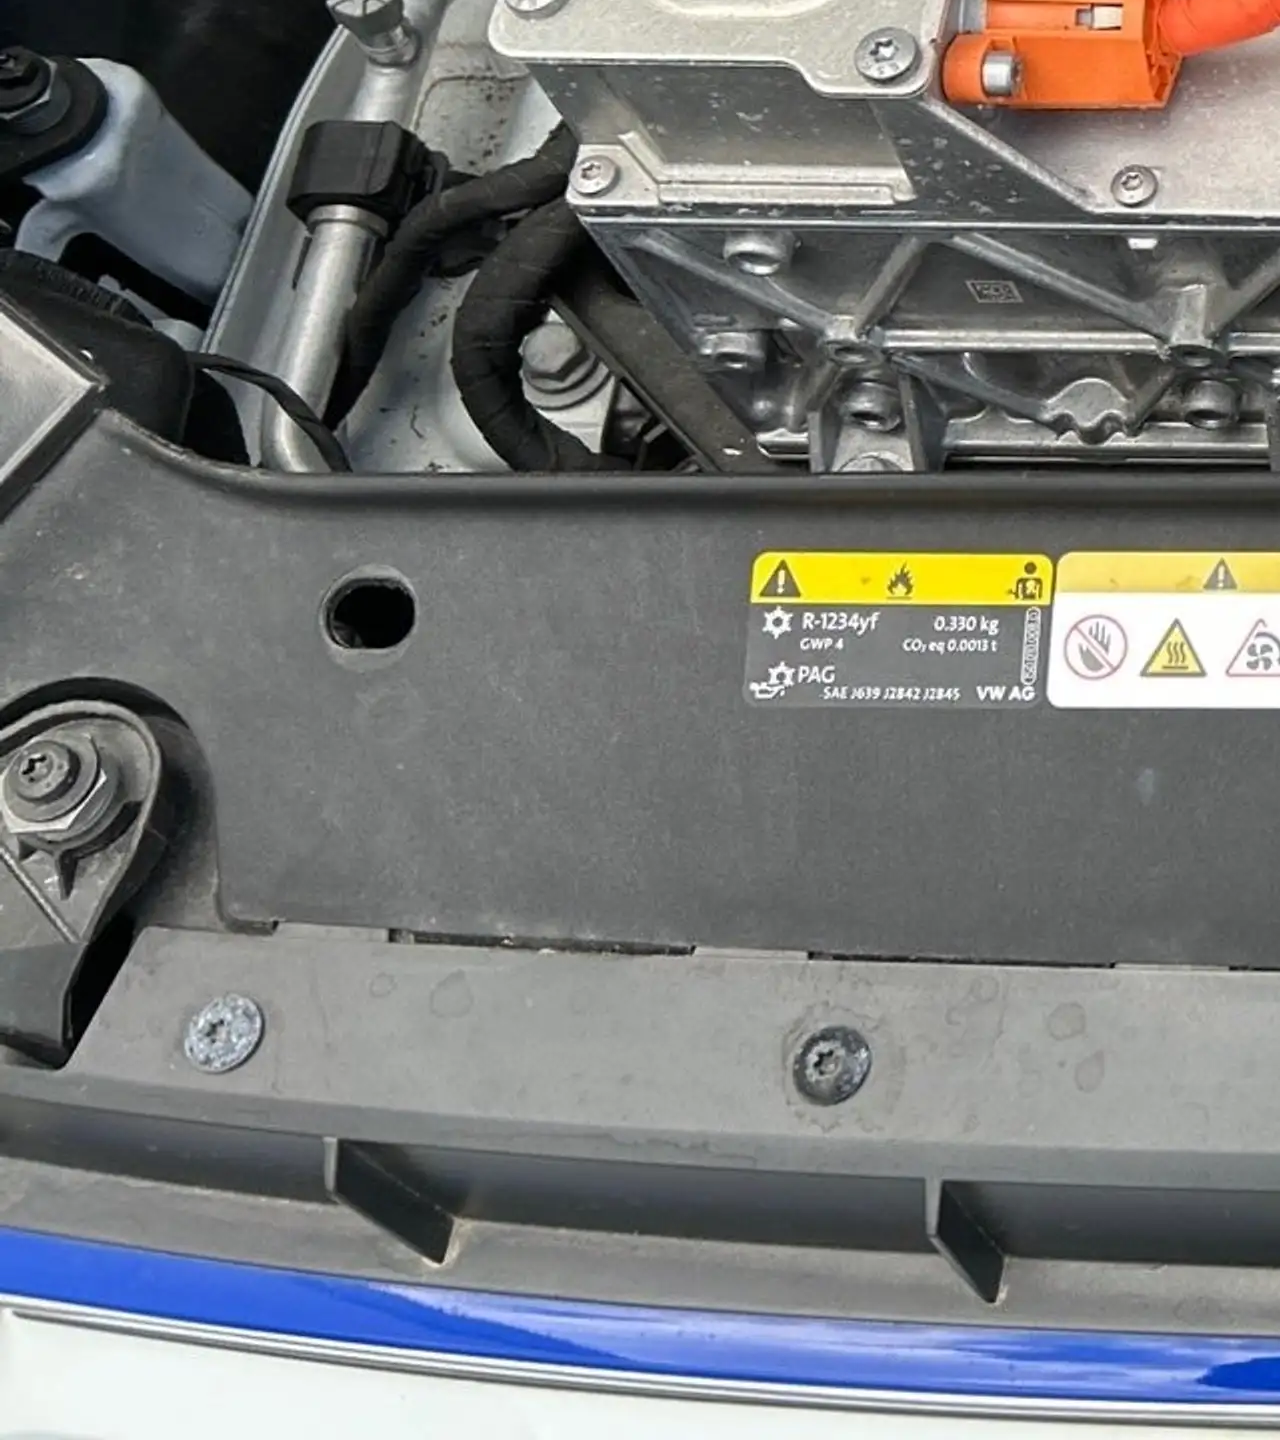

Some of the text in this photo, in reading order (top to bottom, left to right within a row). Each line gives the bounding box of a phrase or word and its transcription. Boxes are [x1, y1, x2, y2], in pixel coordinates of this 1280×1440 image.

[802, 611, 881, 636] R-1234yf
[933, 615, 999, 636] 0.330 kg
[799, 638, 844, 651] GWP 4
[928, 642, 945, 656] eq
[946, 639, 988, 652] 0.0013
[797, 665, 836, 684] PAG
[823, 685, 848, 700] SAE
[850, 686, 880, 701] J639
[976, 685, 1036, 701] VW AG
